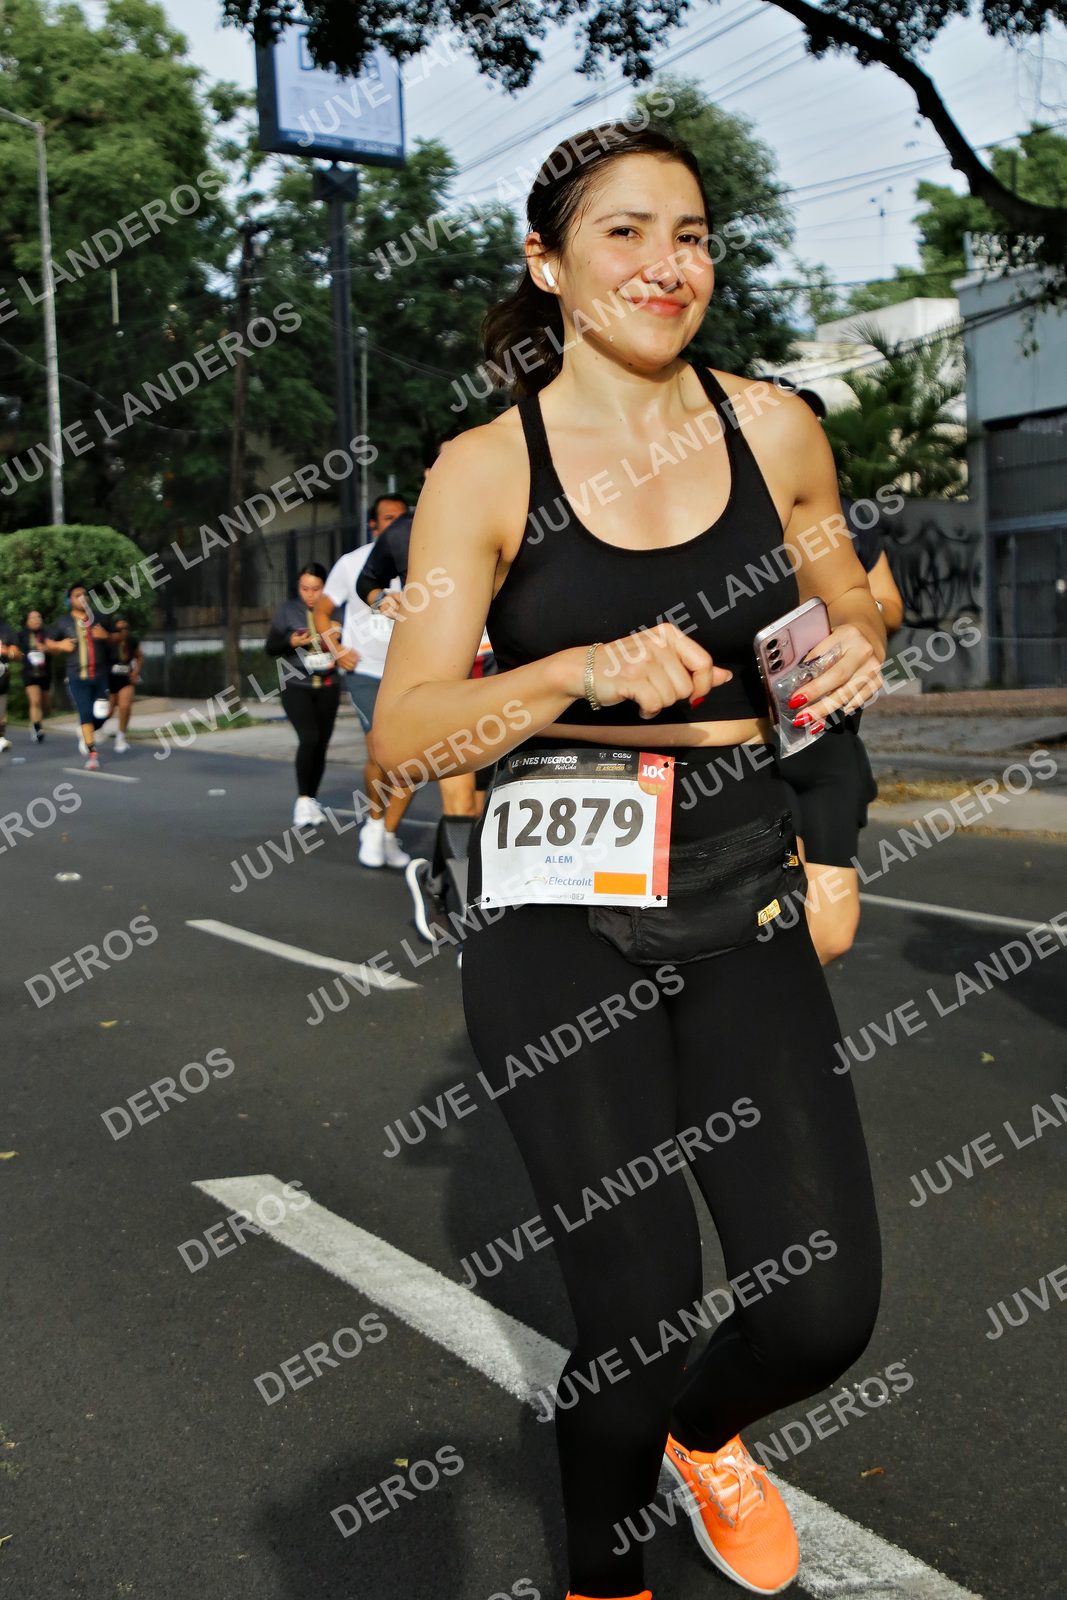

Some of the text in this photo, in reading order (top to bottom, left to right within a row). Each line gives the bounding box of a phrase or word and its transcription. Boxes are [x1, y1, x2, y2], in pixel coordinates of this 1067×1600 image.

[540, 755, 578, 764] NEGROS
[493, 797, 644, 850] 12879
[545, 855, 573, 864] ALEM
[547, 876, 593, 887] Electrolit
